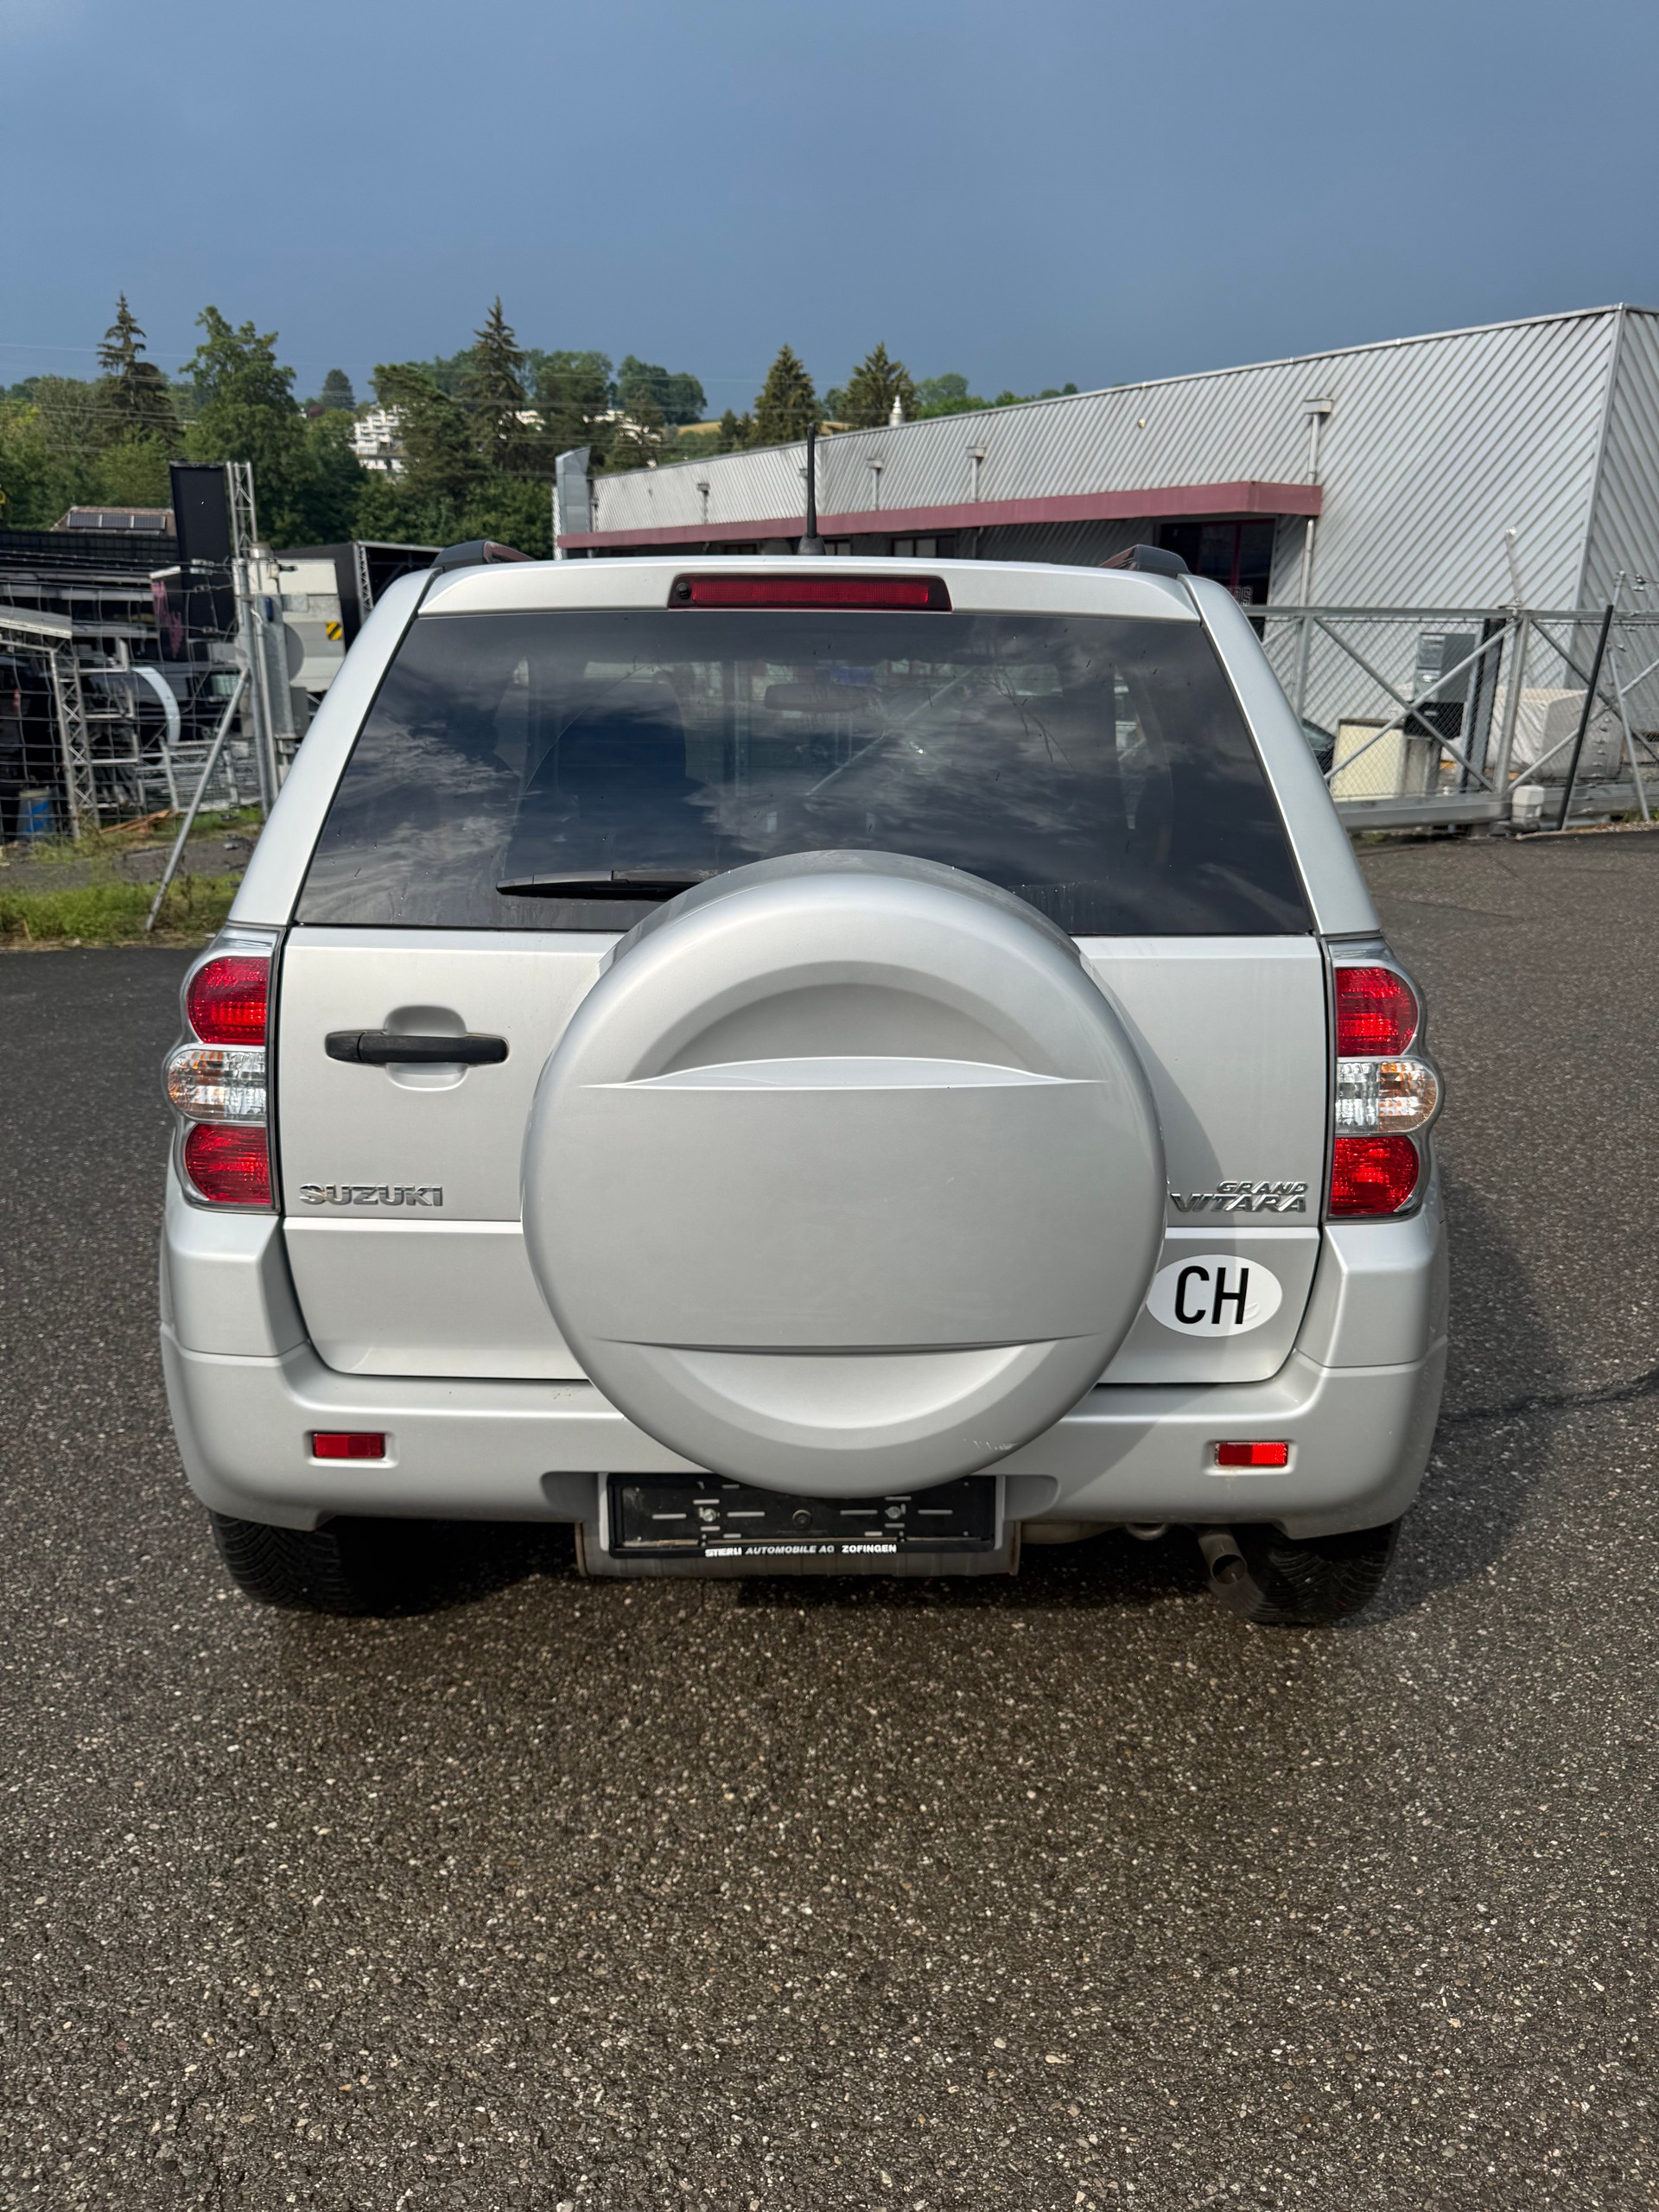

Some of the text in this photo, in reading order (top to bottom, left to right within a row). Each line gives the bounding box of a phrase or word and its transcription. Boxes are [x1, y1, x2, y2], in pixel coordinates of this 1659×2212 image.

[299, 1183, 443, 1207] SUZUKI
[1217, 1180, 1308, 1194] GRAND
[1171, 1193, 1306, 1212] VITARA
[1175, 1265, 1249, 1325] CH
[745, 1545, 817, 1554] AUTOMOBILE
[818, 1545, 835, 1554] AG
[841, 1544, 897, 1554] ZOFINGEN
